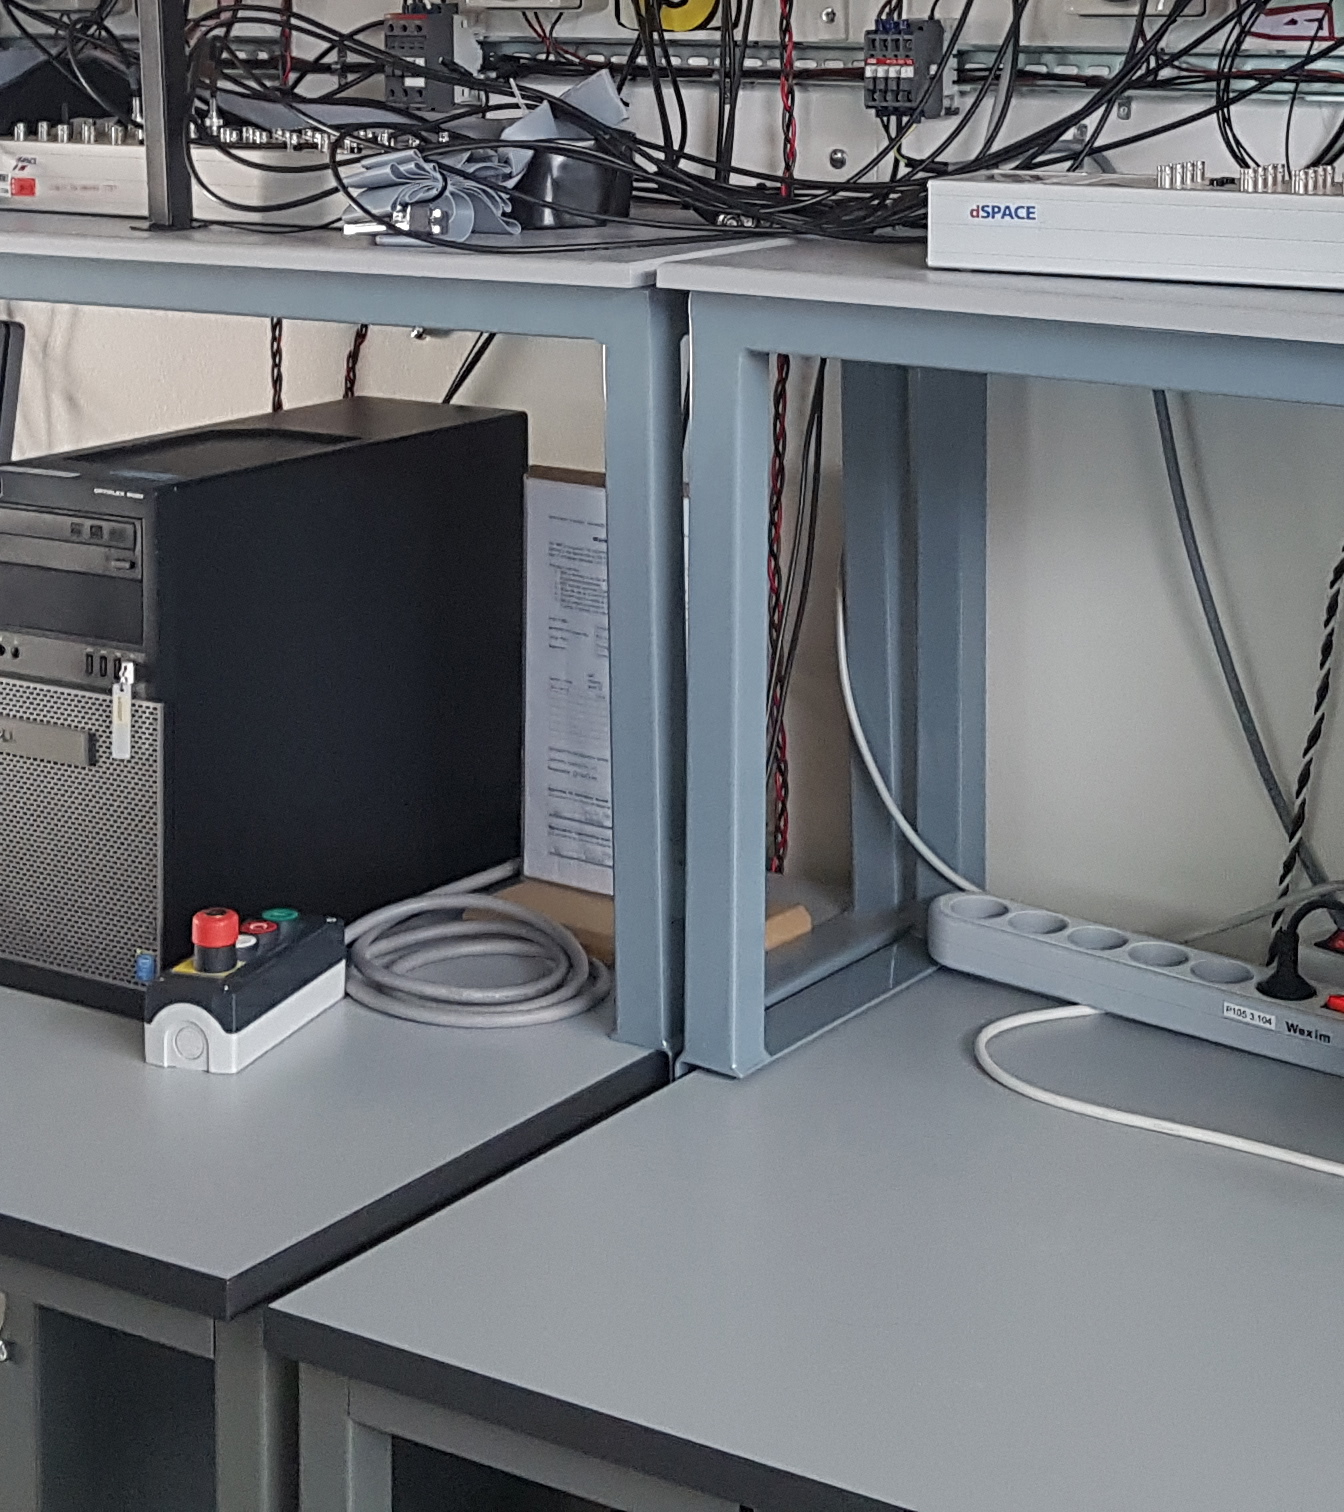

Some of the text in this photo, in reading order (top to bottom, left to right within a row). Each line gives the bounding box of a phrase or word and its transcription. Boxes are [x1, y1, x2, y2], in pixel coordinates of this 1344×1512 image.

[969, 204, 1037, 220] dSPACE
[1225, 1005, 1248, 1019] P105
[1284, 1020, 1332, 1044] Wexim
